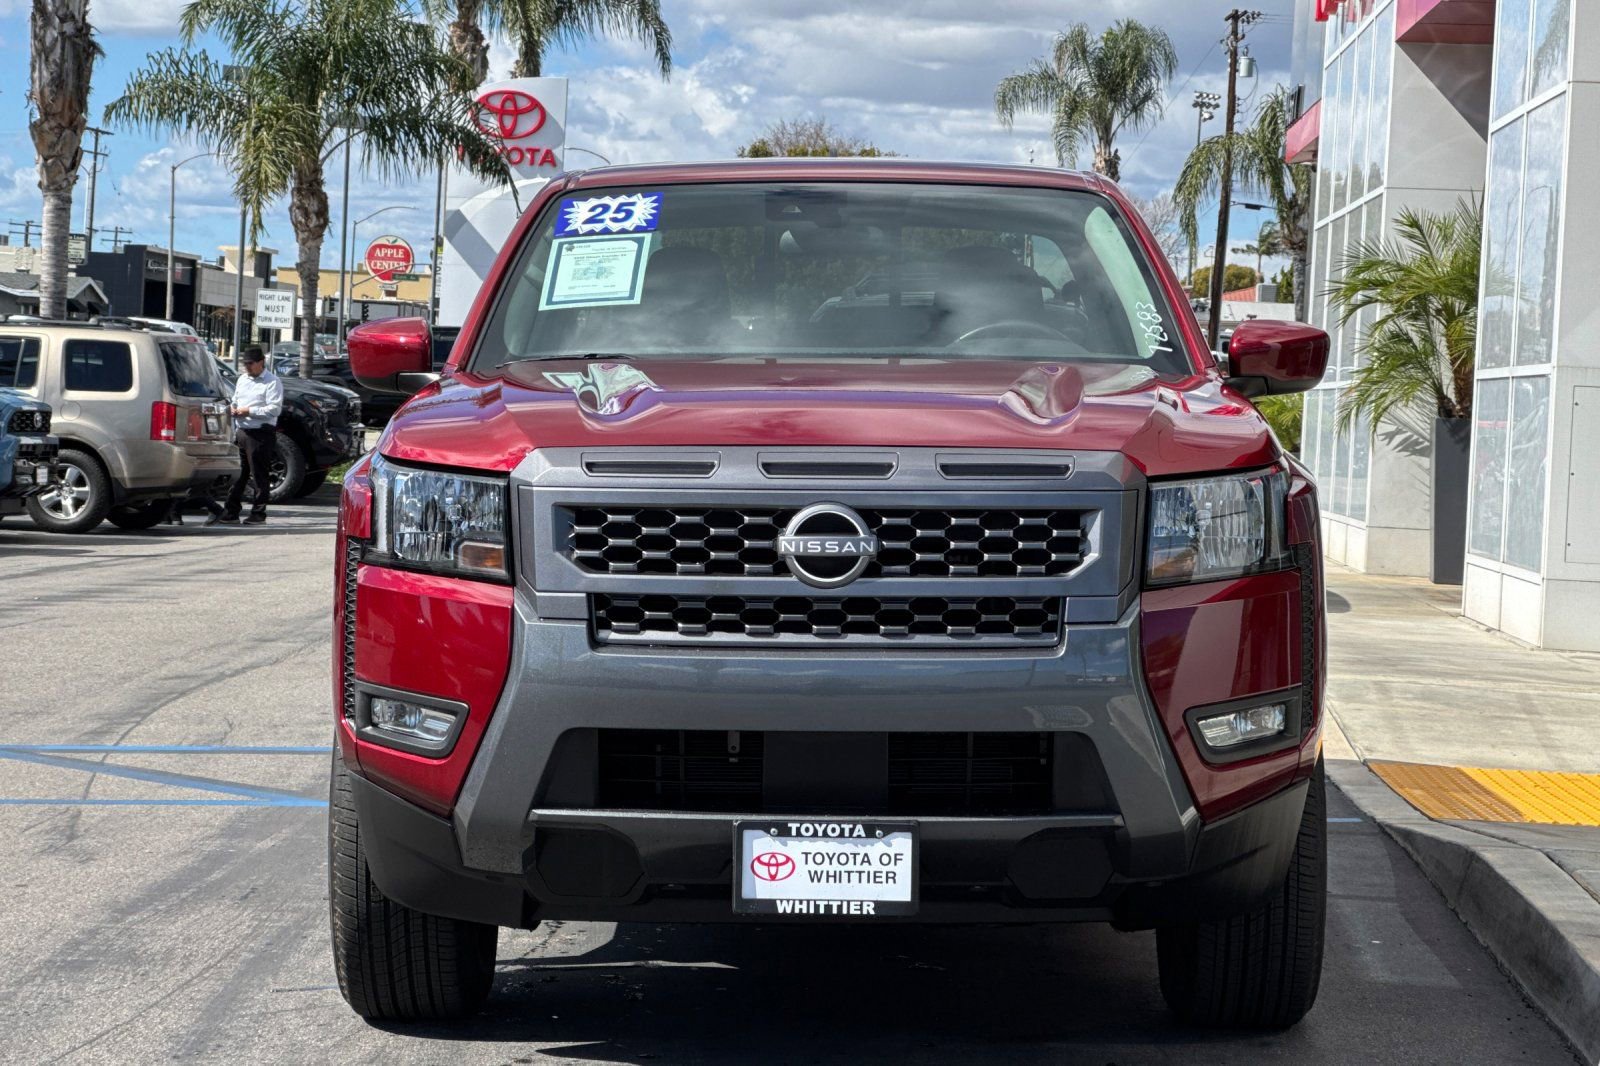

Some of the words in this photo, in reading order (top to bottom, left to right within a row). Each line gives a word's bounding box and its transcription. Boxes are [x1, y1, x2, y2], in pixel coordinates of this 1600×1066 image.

[581, 201, 638, 225] 25
[374, 248, 405, 259] APPLE
[370, 260, 406, 271] CENTER
[264, 304, 285, 313] MUST
[258, 315, 273, 323] TURN
[781, 540, 874, 553] NISSAN
[787, 823, 866, 838] TOYOTA
[801, 851, 872, 867] TOYOTA
[879, 853, 904, 867] OF
[807, 870, 897, 885] WHITTIER
[776, 899, 876, 915] WHITTIER
